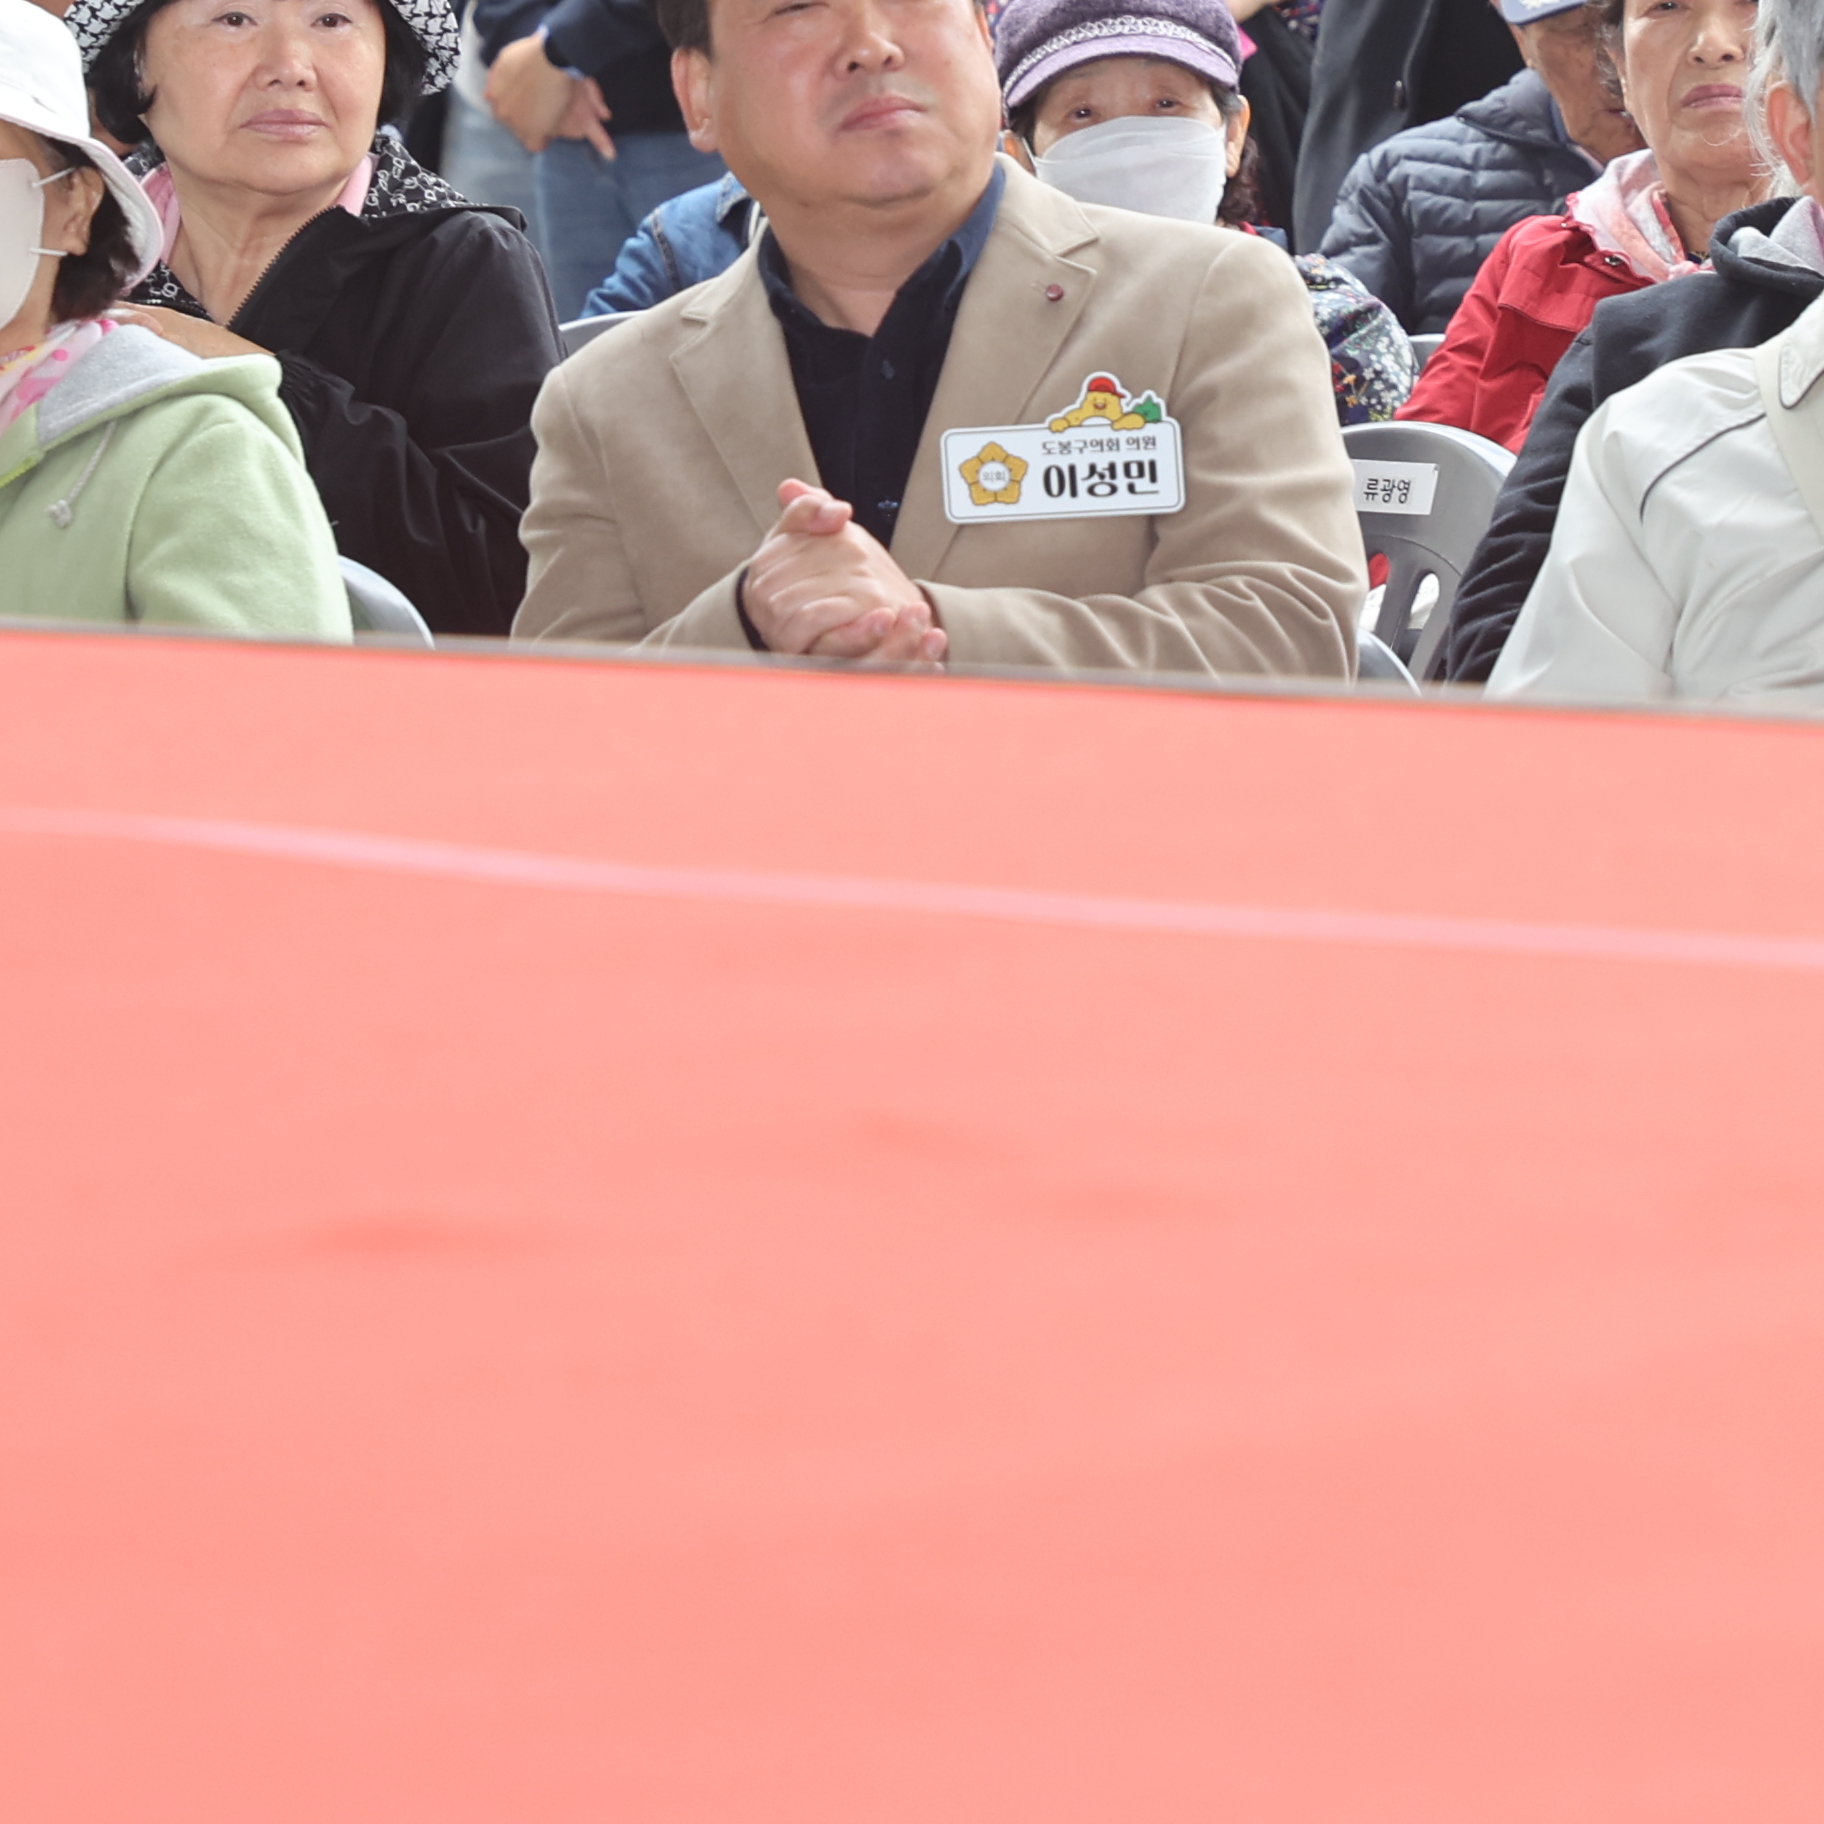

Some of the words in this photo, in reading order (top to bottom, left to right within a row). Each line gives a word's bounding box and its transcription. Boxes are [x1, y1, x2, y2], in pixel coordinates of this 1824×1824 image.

[1041, 437, 1121, 456] 도봉구의회
[1125, 435, 1157, 452] 의원
[1042, 458, 1160, 499] 이성민
[1363, 477, 1412, 504] 류광영
